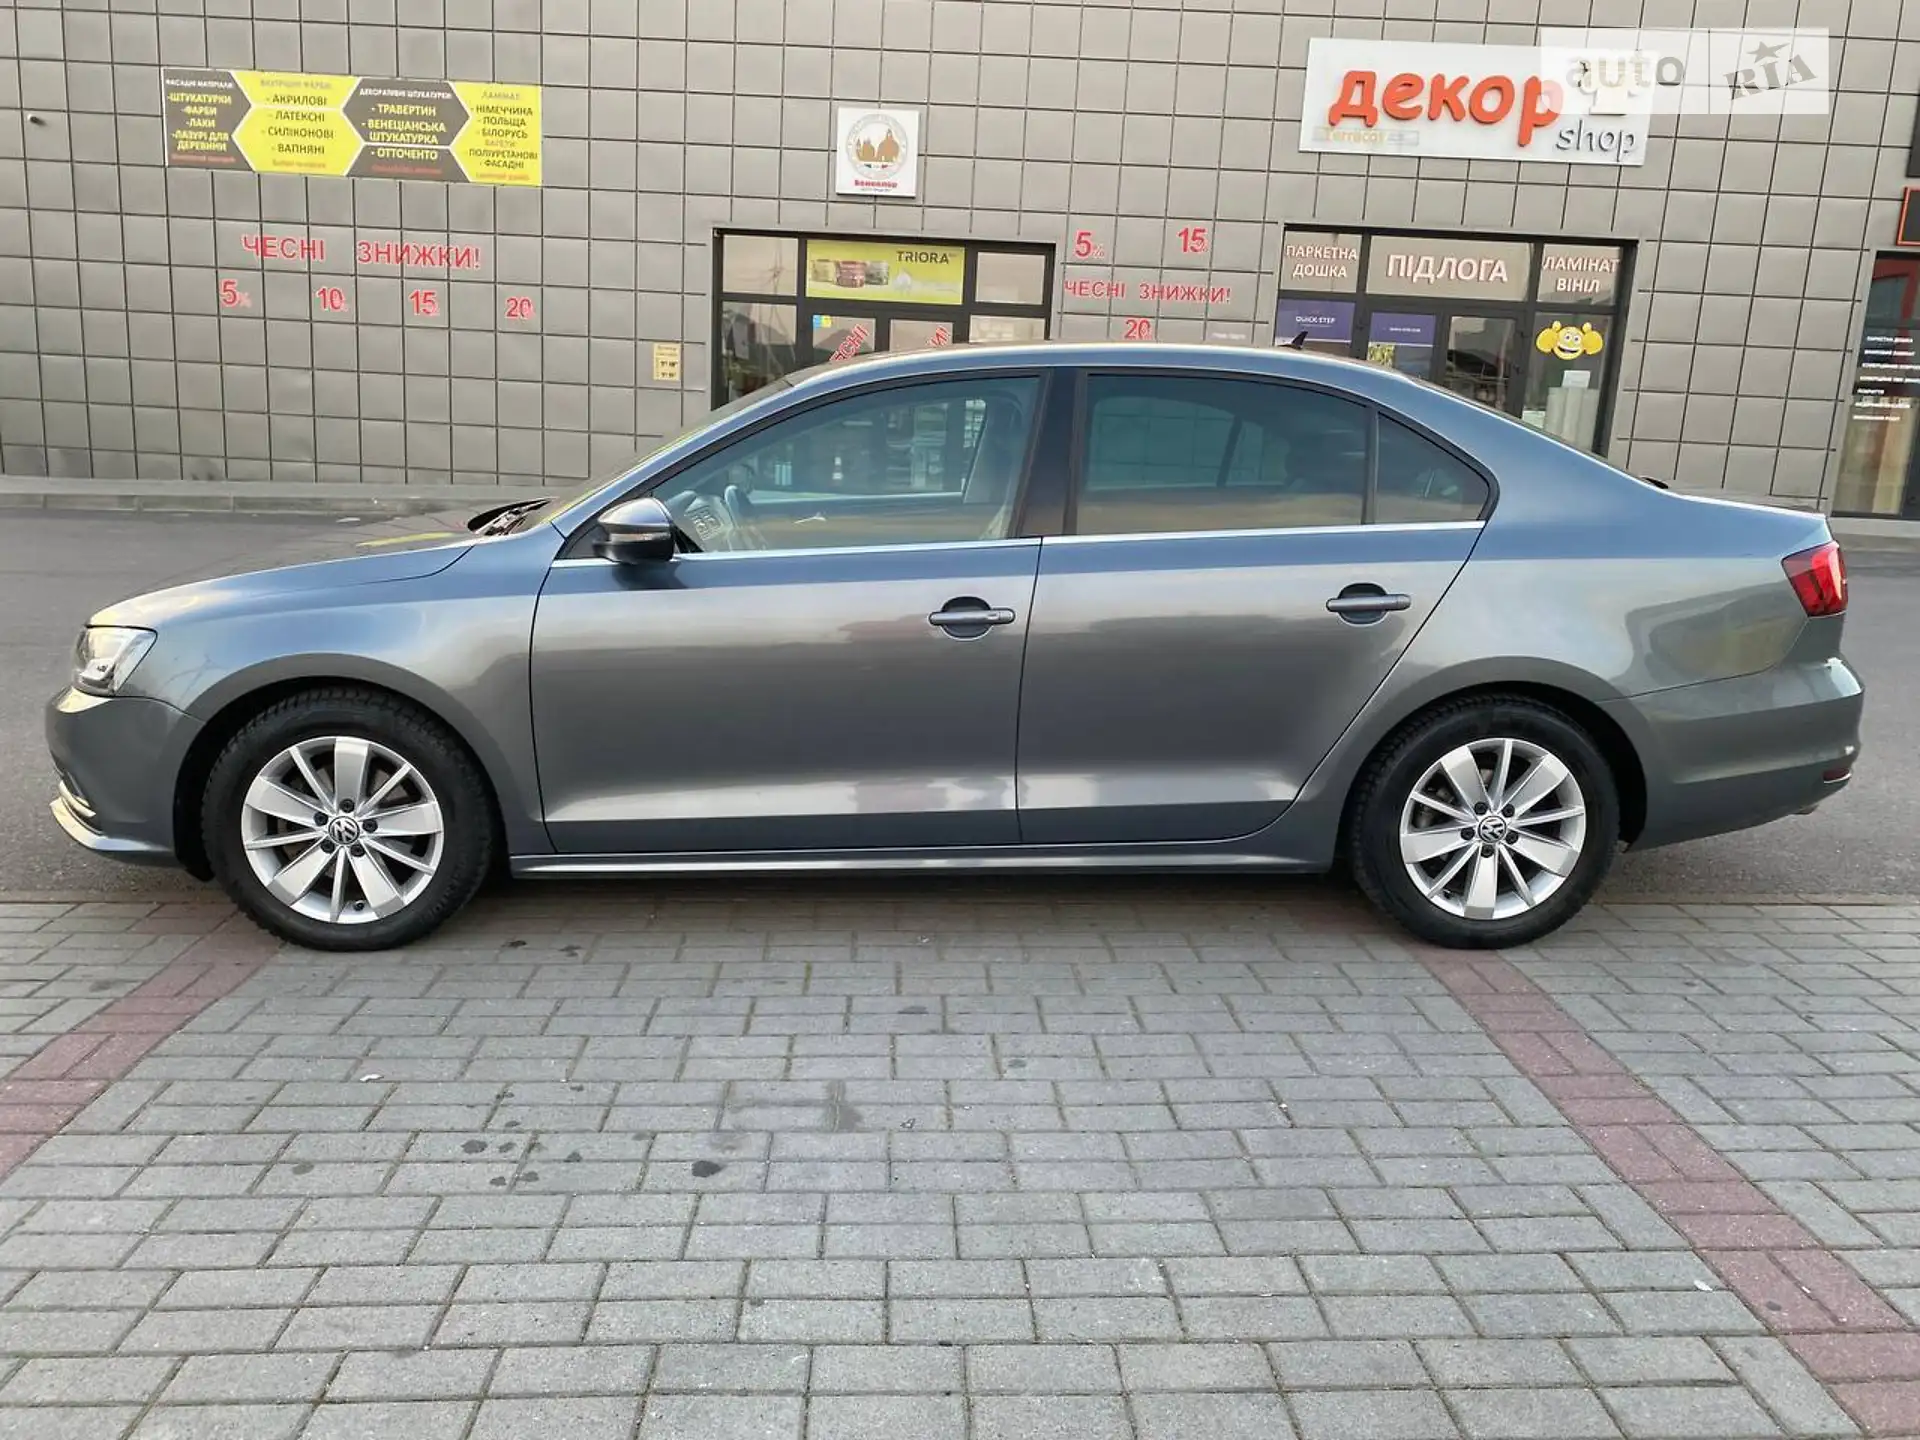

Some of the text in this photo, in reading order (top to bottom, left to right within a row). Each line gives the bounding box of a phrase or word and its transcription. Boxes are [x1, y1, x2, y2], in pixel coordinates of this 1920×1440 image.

[377, 103, 437, 116] ТРАВЕРТИН
[1328, 70, 1564, 147] декор
[369, 132, 439, 145] ШТУКАТУРКА
[1556, 119, 1636, 162] shop
[377, 148, 439, 161] ОТТОЧЕНТО
[241, 235, 481, 270] ЧЕСНІ ЗНИЖКИ!
[896, 250, 950, 265] TRIORA
[1285, 245, 1358, 261] ПАРКЕТНА
[1292, 264, 1348, 280] ДОШКА
[1387, 253, 1509, 285] ПІДЛОГА
[1541, 256, 1621, 275] ЛАМІНАТ
[1064, 279, 1232, 305] ЧЕСНІ ЗНИЖКИ!
[1556, 277, 1601, 294] ВІНІЛ
